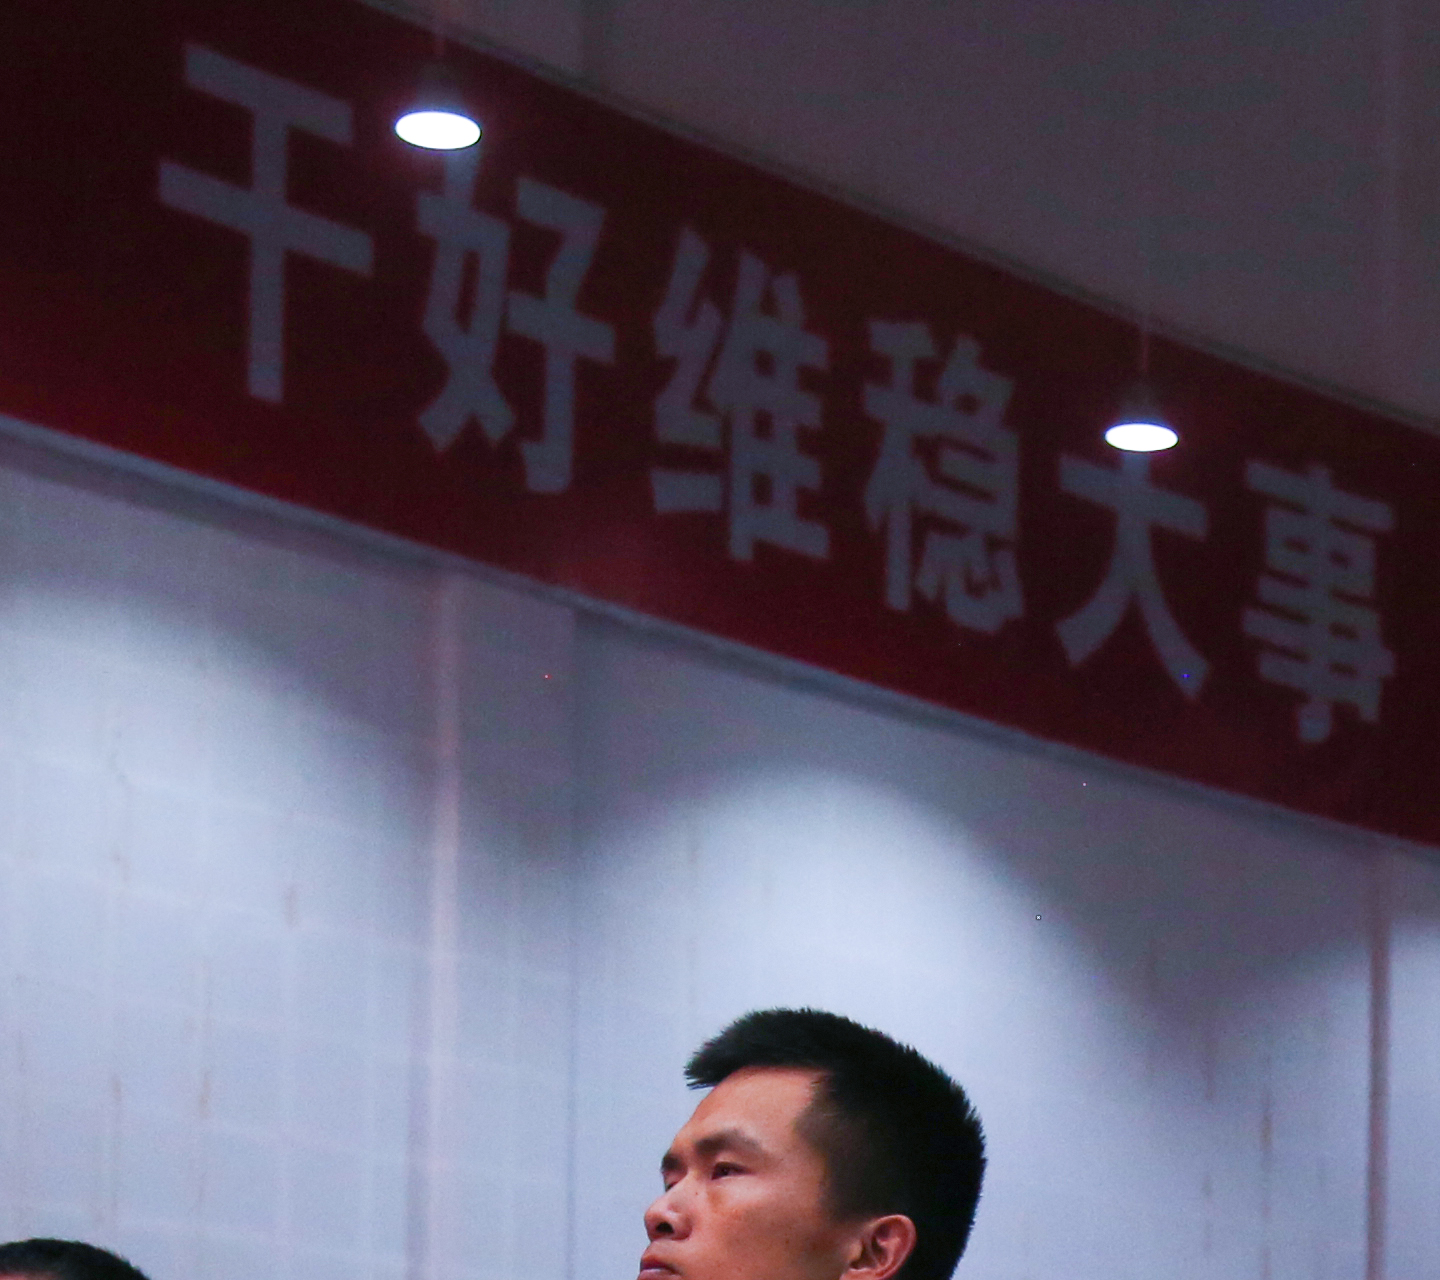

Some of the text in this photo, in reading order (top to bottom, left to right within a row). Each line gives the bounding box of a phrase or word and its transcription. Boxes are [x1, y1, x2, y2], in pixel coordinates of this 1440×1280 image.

[158, 44, 1398, 744] 干好维稳大事
